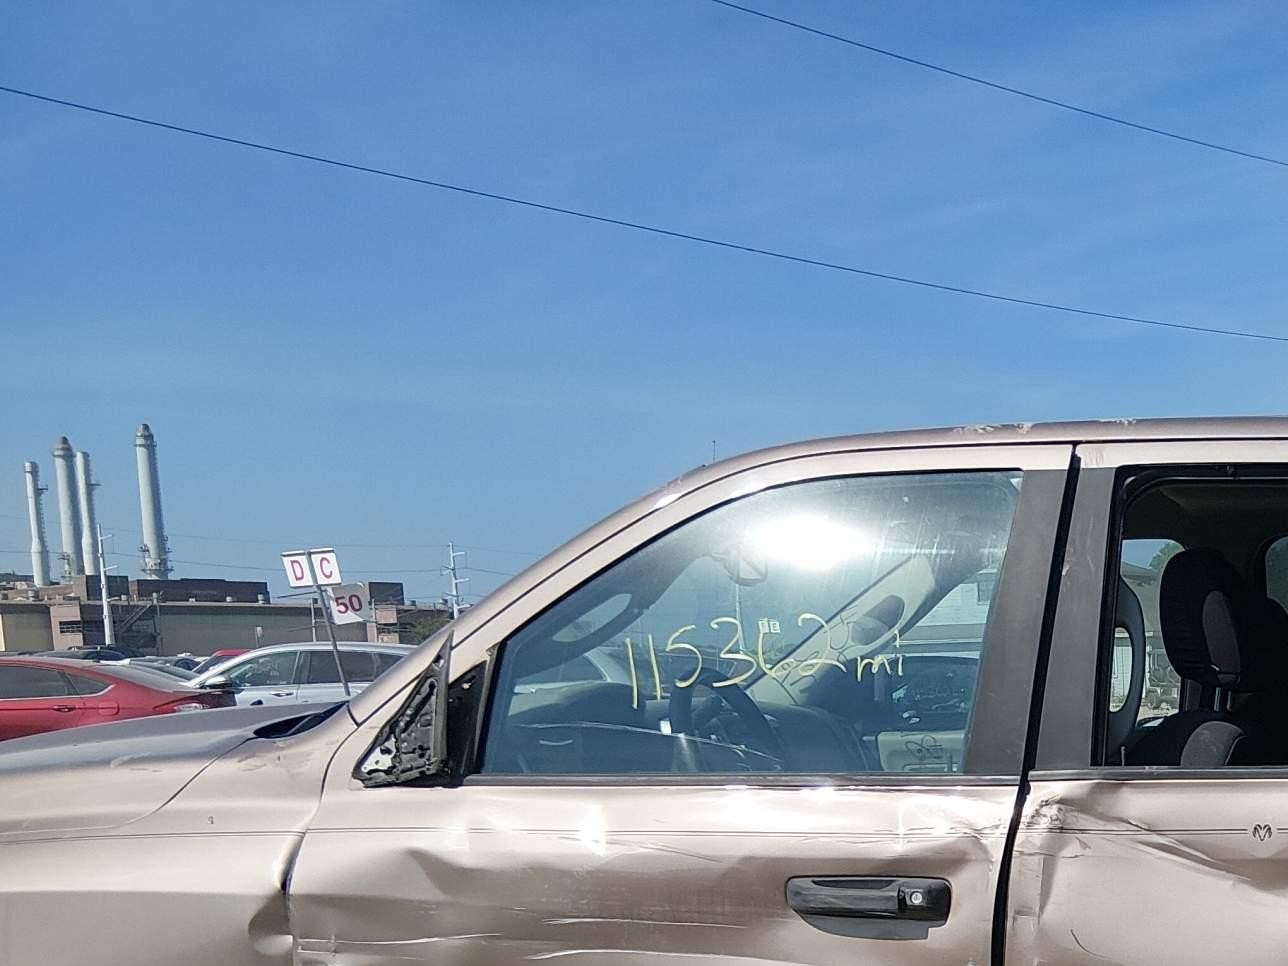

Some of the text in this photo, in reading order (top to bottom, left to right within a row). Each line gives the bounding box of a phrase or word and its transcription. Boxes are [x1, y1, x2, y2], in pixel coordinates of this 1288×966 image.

[290, 557, 333, 581] D C
[334, 594, 363, 614] 50
